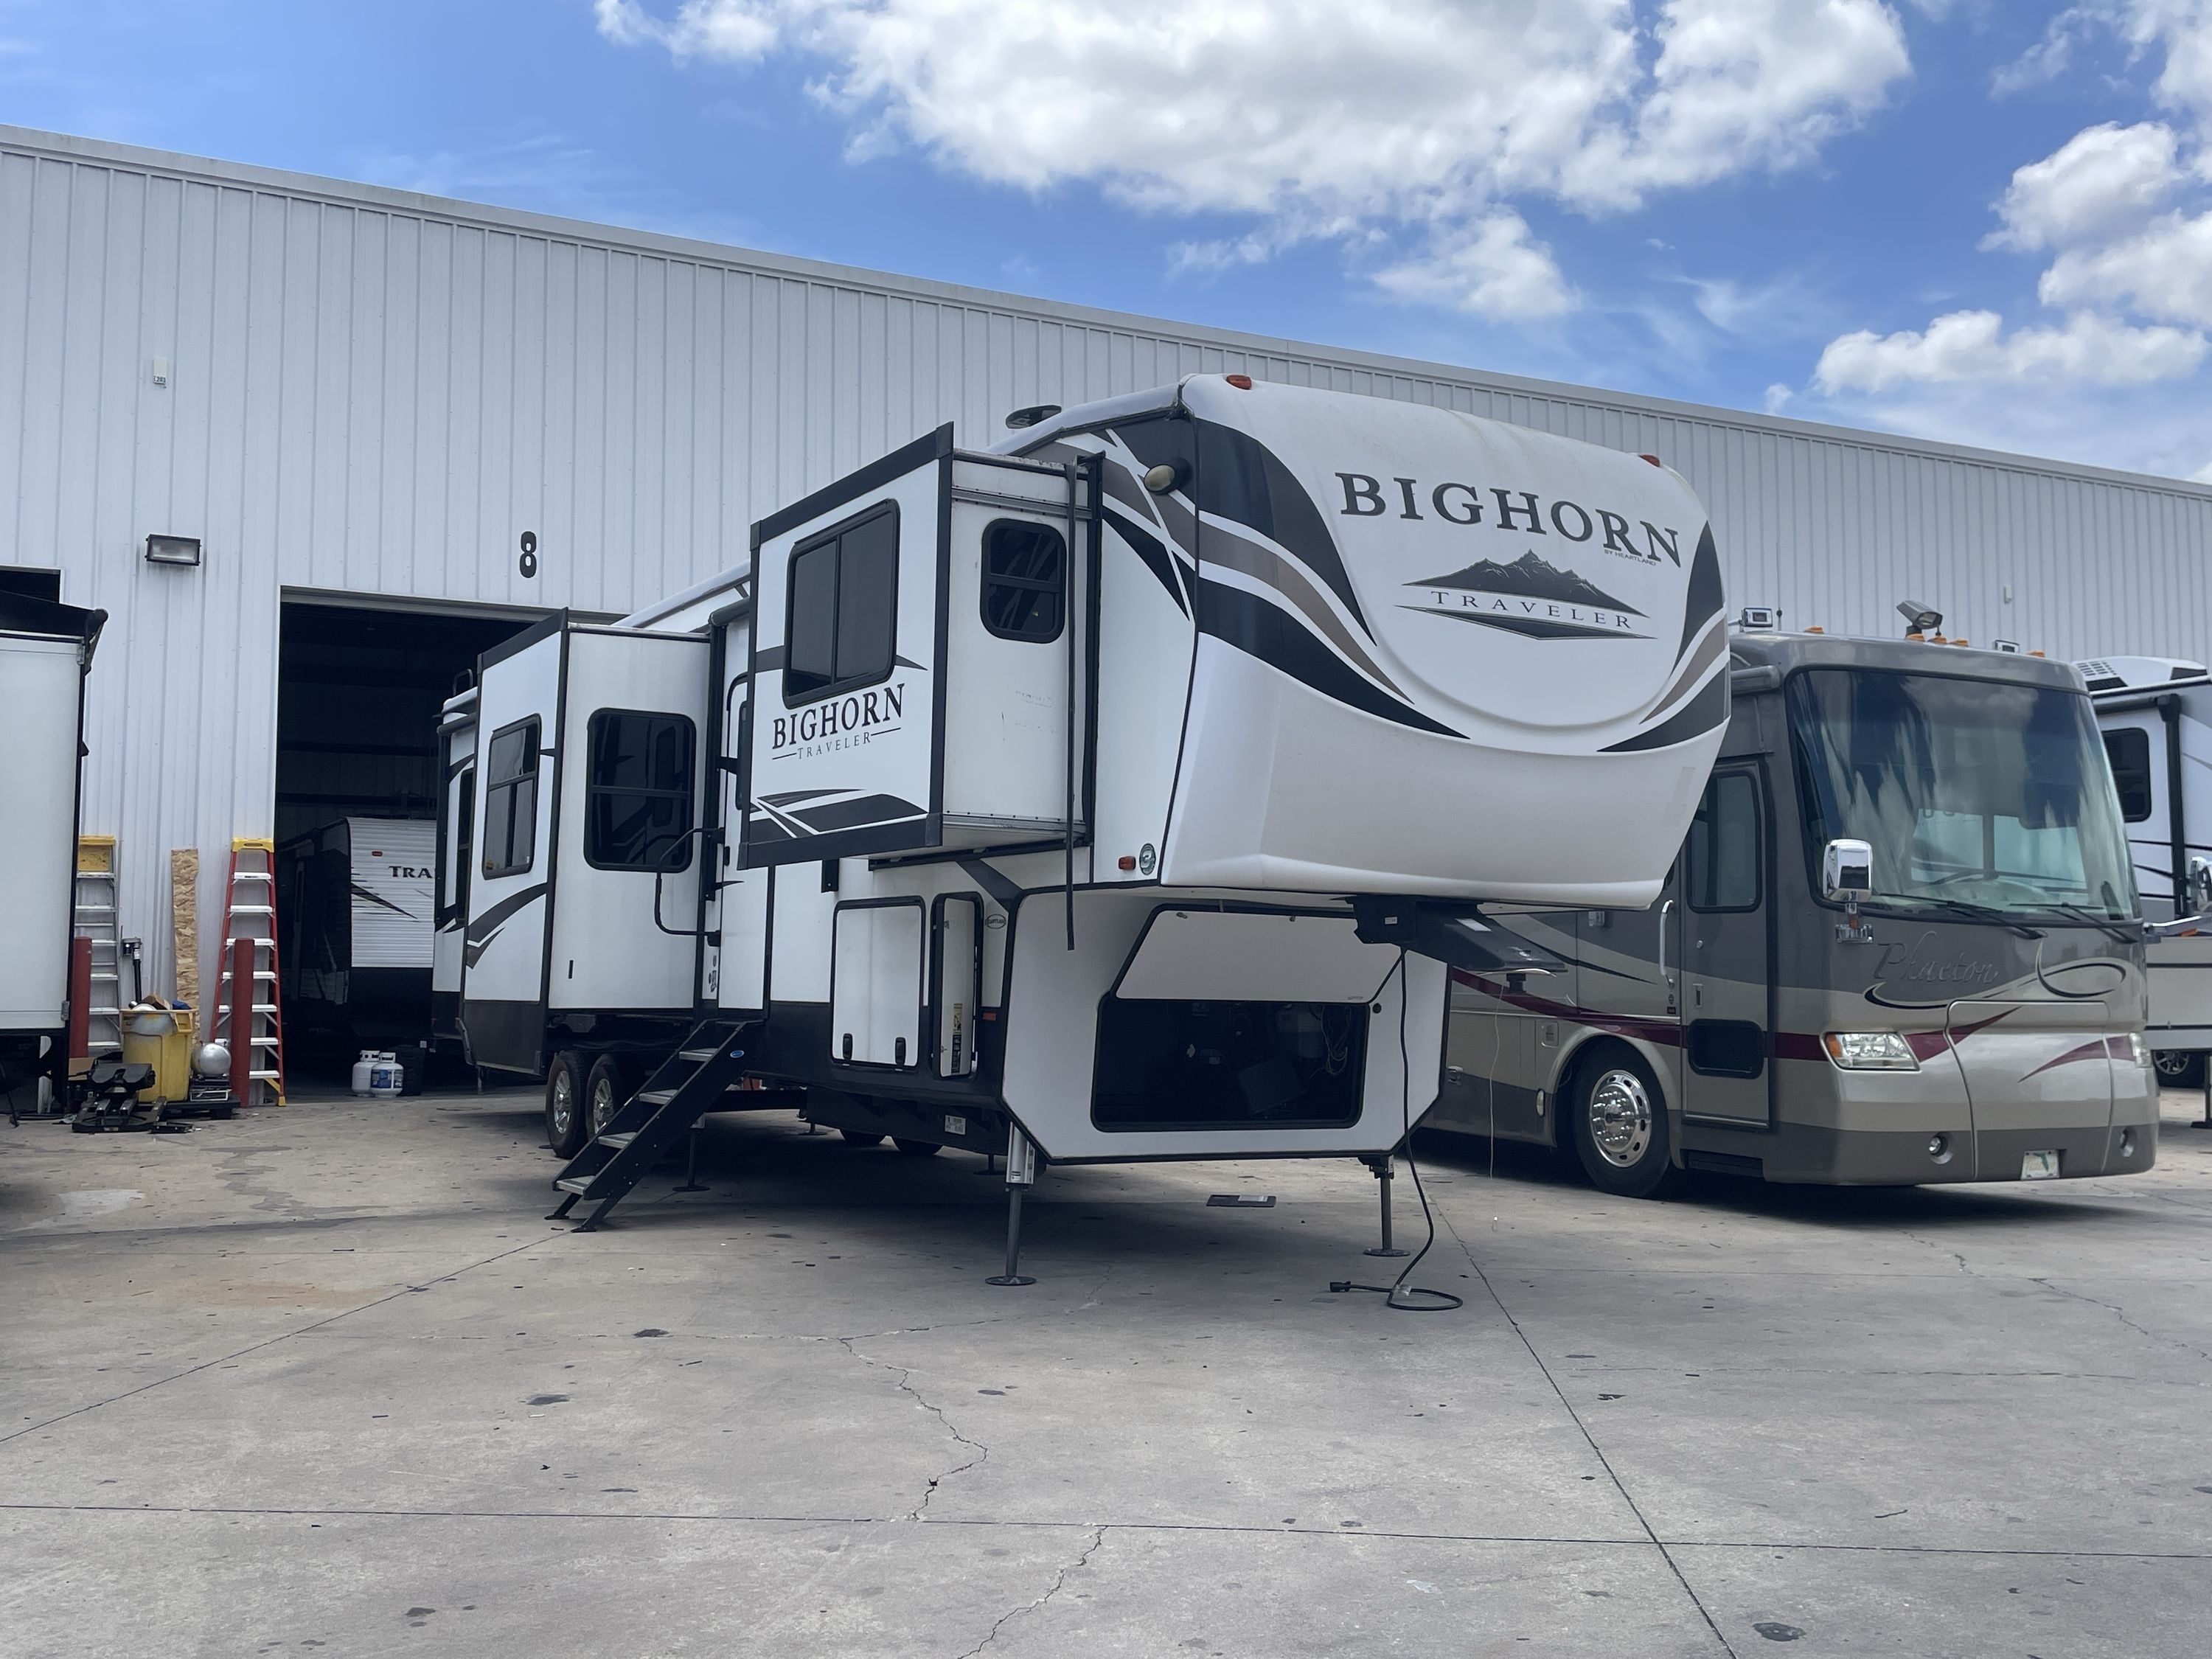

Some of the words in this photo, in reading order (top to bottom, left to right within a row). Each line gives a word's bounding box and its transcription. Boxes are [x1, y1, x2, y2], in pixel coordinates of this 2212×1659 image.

[1335, 472, 1680, 568] BIGHORN
[519, 531, 537, 579] 8
[1615, 551, 1656, 566] HEARTLAND
[1430, 590, 1632, 629] TRAVELER
[772, 683, 904, 750] BIGHORN
[797, 731, 871, 759] TRAVELER
[1874, 931, 1998, 984] Phaeton
